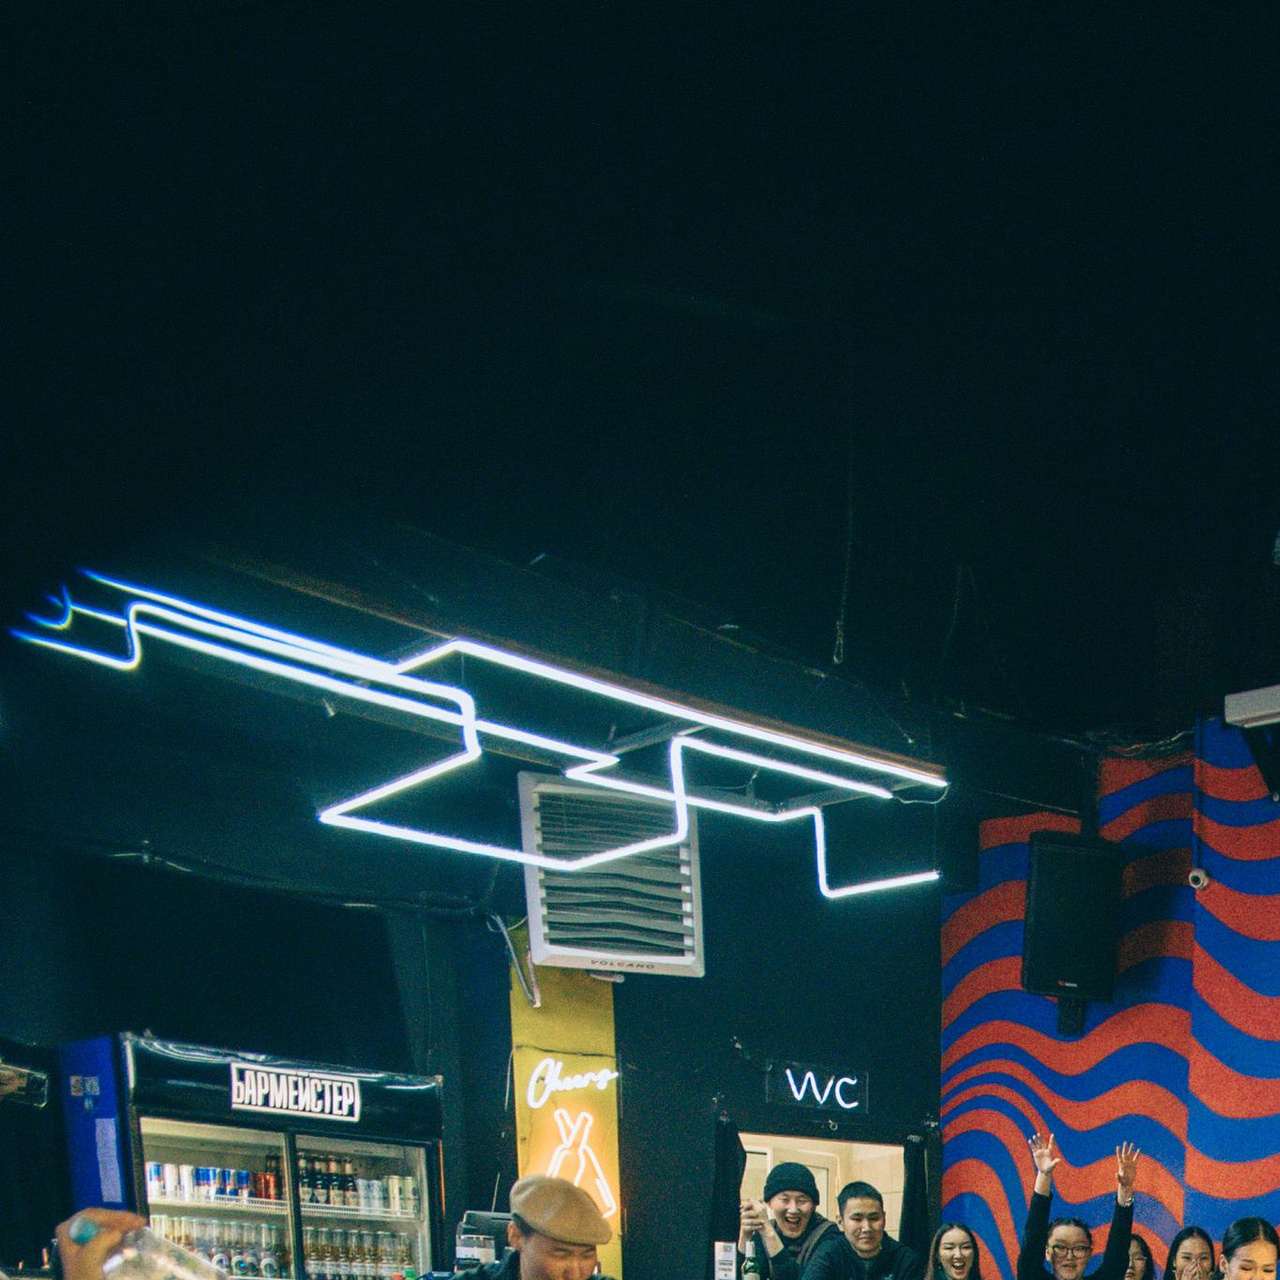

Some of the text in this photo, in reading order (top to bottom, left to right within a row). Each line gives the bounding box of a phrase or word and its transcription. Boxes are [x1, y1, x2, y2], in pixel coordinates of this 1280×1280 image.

[590, 959, 655, 970] VOLCANO
[231, 1062, 356, 1119] БАРМЕЙСТЕР
[785, 1068, 859, 1109] WC
